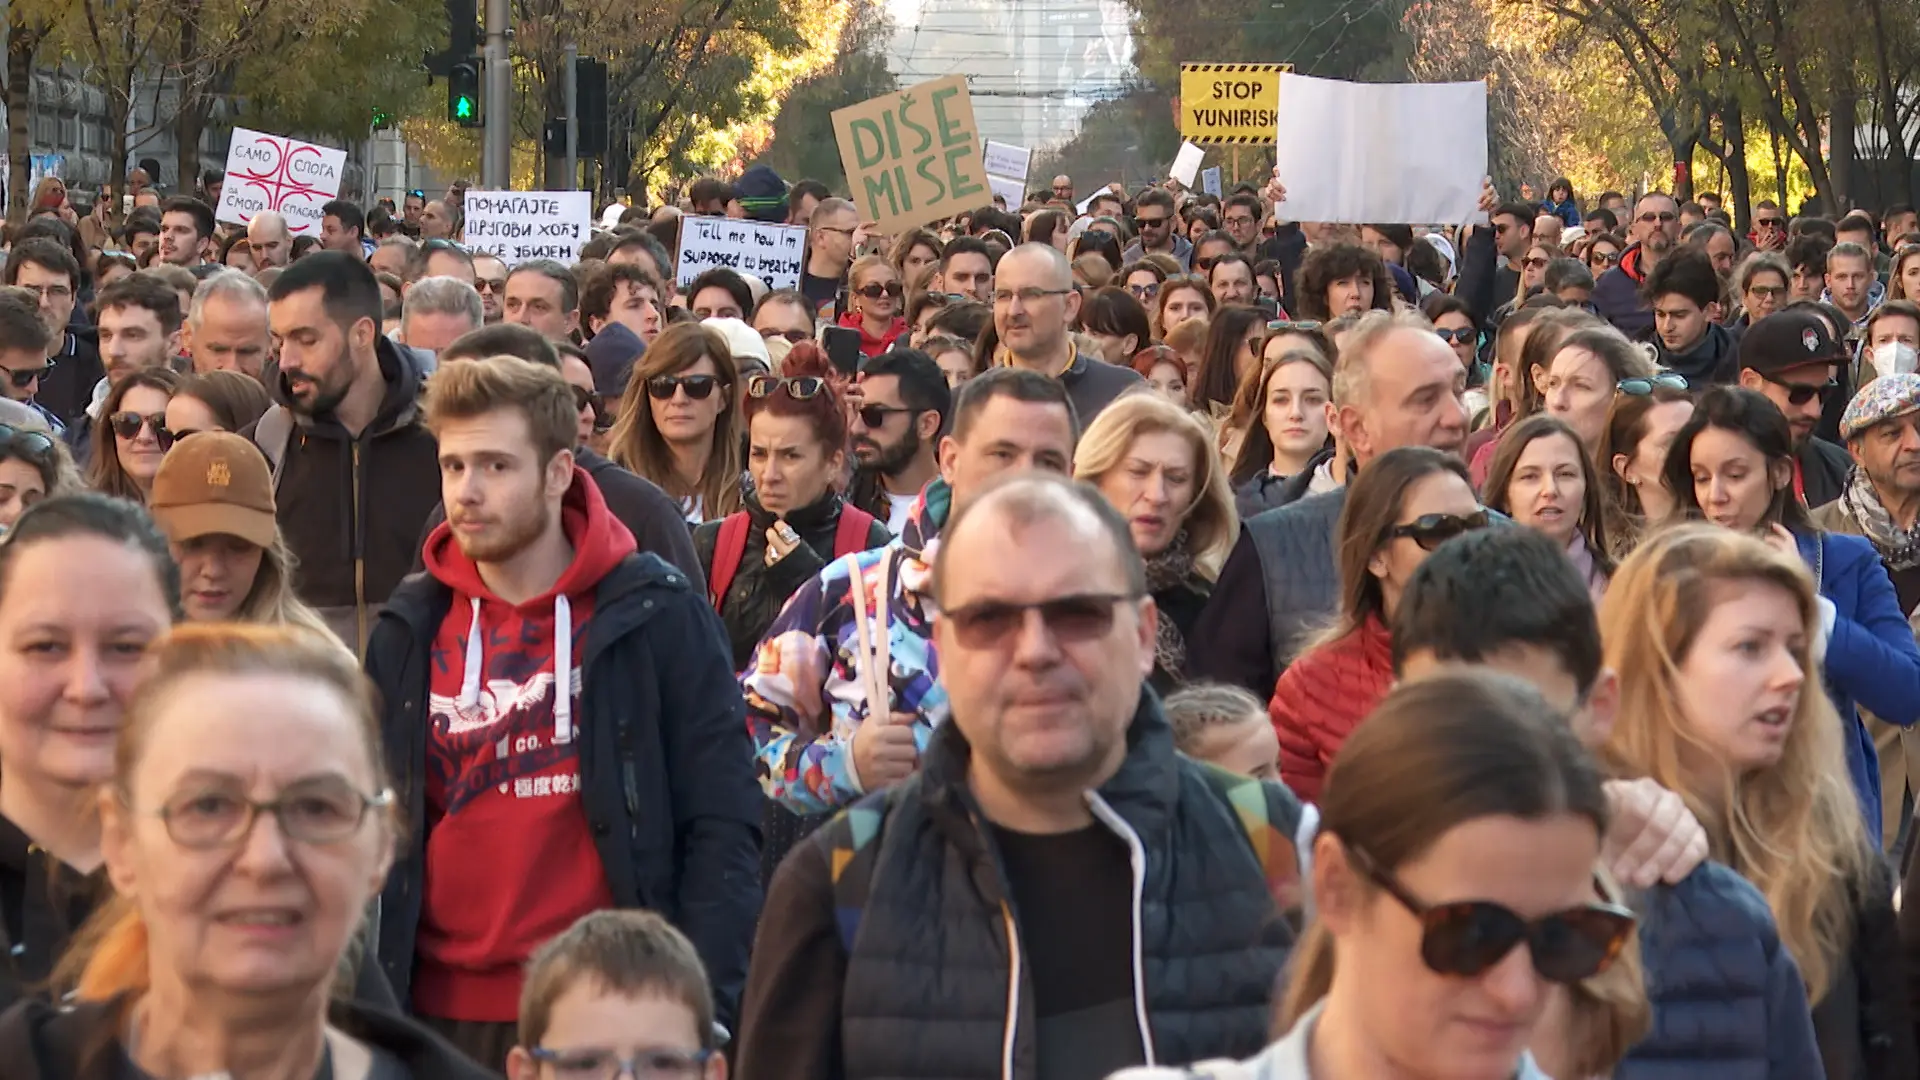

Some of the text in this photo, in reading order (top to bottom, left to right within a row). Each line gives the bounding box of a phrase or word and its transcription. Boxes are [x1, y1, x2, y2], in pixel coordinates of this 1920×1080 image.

[1212, 81, 1263, 100] STOP
[850, 87, 971, 169] DIŠE
[234, 145, 271, 162] САМО
[862, 145, 984, 221] MISE
[226, 195, 263, 212] СМОГА
[695, 222, 797, 250] Tell me how I'm
[744, 255, 756, 270] to
[758, 254, 801, 275] breathe
